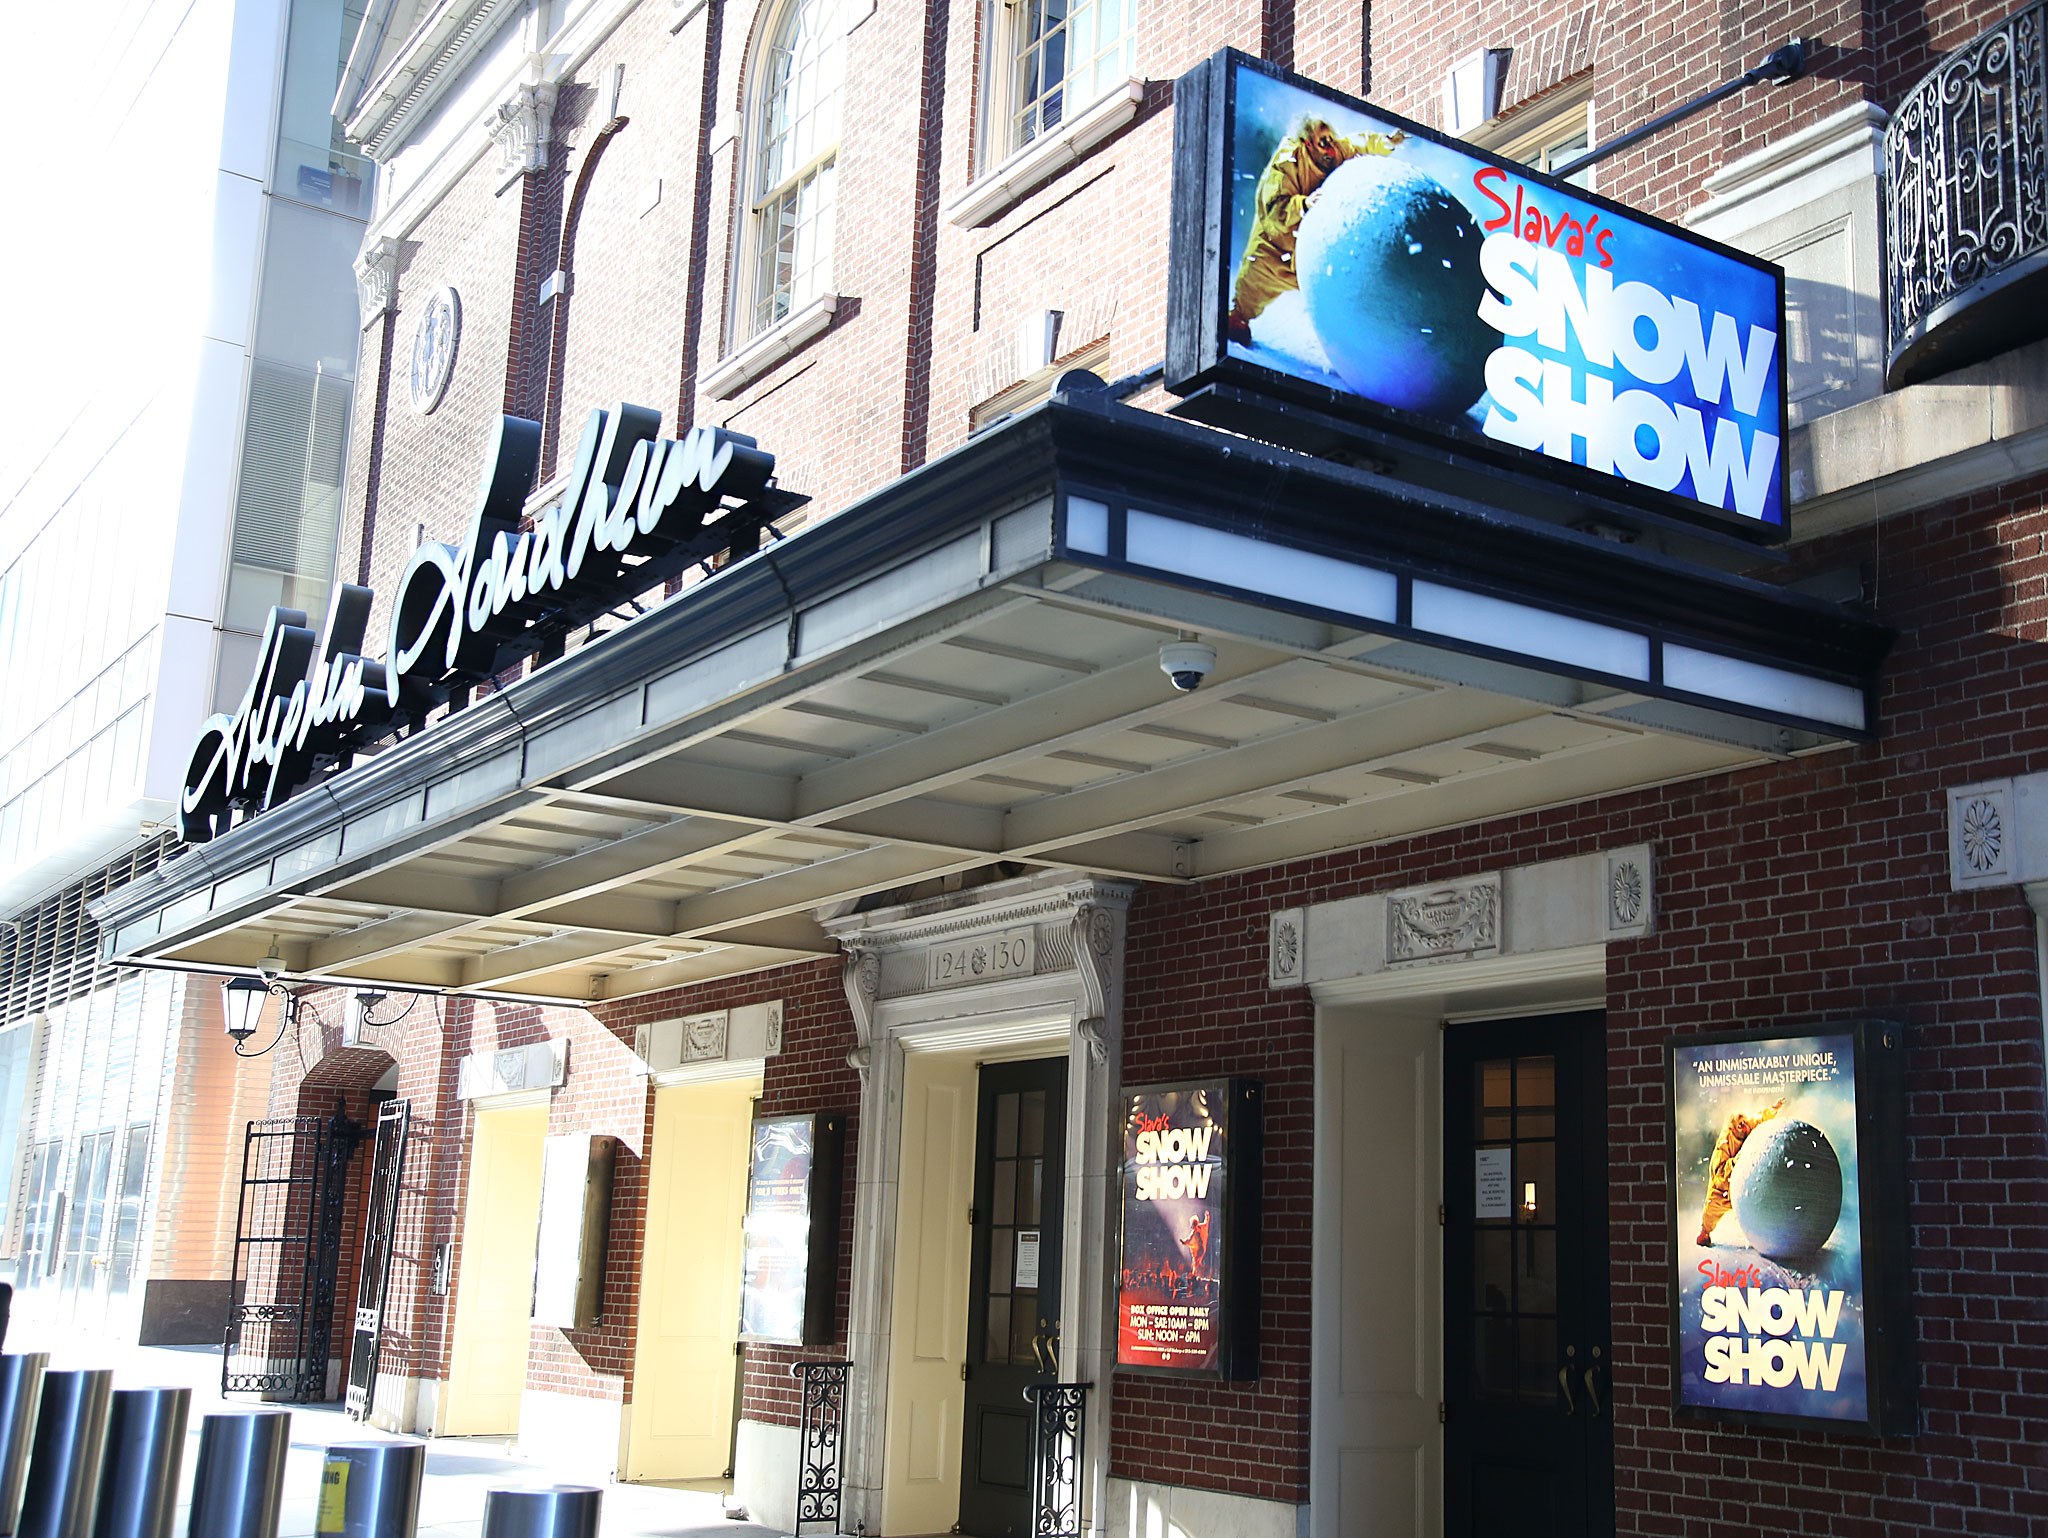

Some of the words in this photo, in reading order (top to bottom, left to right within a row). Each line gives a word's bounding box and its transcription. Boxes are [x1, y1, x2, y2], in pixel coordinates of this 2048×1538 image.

[1473, 166, 1614, 268] Slava's
[1477, 231, 1777, 417] SNOW
[1482, 345, 1780, 520] SHOW
[176, 581, 368, 843] Stephen
[385, 401, 734, 707] Sondheim
[934, 952, 966, 980] 124
[991, 938, 1026, 970] 130
[1699, 1071, 1760, 1088] UNMISSABLE
[1715, 1055, 1790, 1073] UNMISTAKABLY
[1793, 1052, 1837, 1067] UNIQUE,
[1135, 1111, 1170, 1134] Slava's
[1136, 1127, 1212, 1164] SNOW
[1136, 1164, 1212, 1200] SHOW
[1697, 1259, 1762, 1289] Slava's
[1130, 1304, 1145, 1315] BOX
[1146, 1305, 1168, 1316] OFFICE
[1169, 1306, 1188, 1316] OPEN
[1189, 1307, 1210, 1317] DAILY
[1130, 1316, 1148, 1327] MON
[1194, 1319, 1209, 1330] 8PM
[1700, 1285, 1845, 1339] SNOW
[1137, 1328, 1154, 1341] SUN:
[1155, 1329, 1179, 1342] NOON
[1185, 1331, 1200, 1342] 6PM
[1703, 1335, 1848, 1392] SHOW
